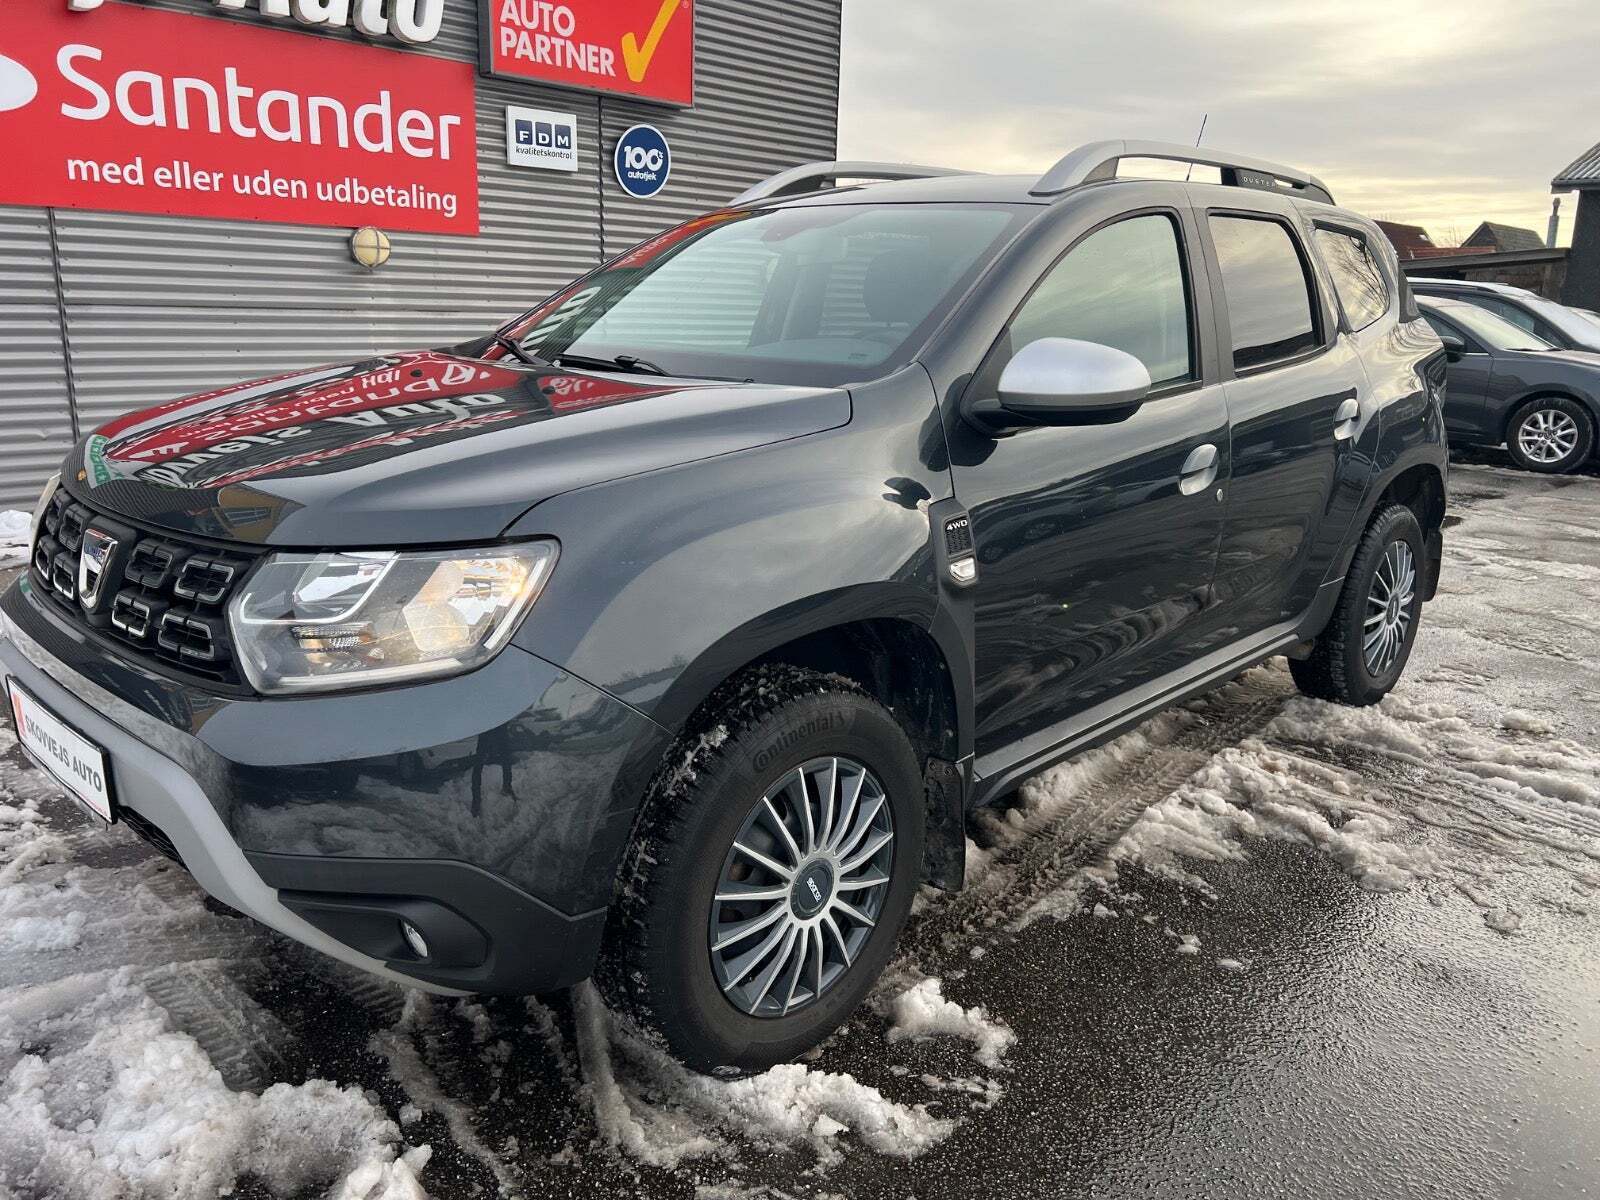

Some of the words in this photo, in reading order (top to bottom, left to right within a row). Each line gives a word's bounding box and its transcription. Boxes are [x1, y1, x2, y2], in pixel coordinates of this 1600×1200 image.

[499, 0, 576, 37] AUTO
[500, 26, 616, 77] PARTNER
[56, 43, 461, 160] Santander
[515, 146, 572, 159] kvalitetskontrol
[519, 130, 569, 147] FDM
[67, 156, 145, 186] med
[153, 160, 224, 193] eller
[232, 169, 308, 199] uden
[316, 176, 458, 218] udbetaling
[627, 171, 657, 182] autotjek
[946, 519, 968, 531] 4WD
[25, 714, 70, 768] SKOVVEJS
[73, 756, 102, 793] AUTO
[753, 712, 835, 773] Continental
